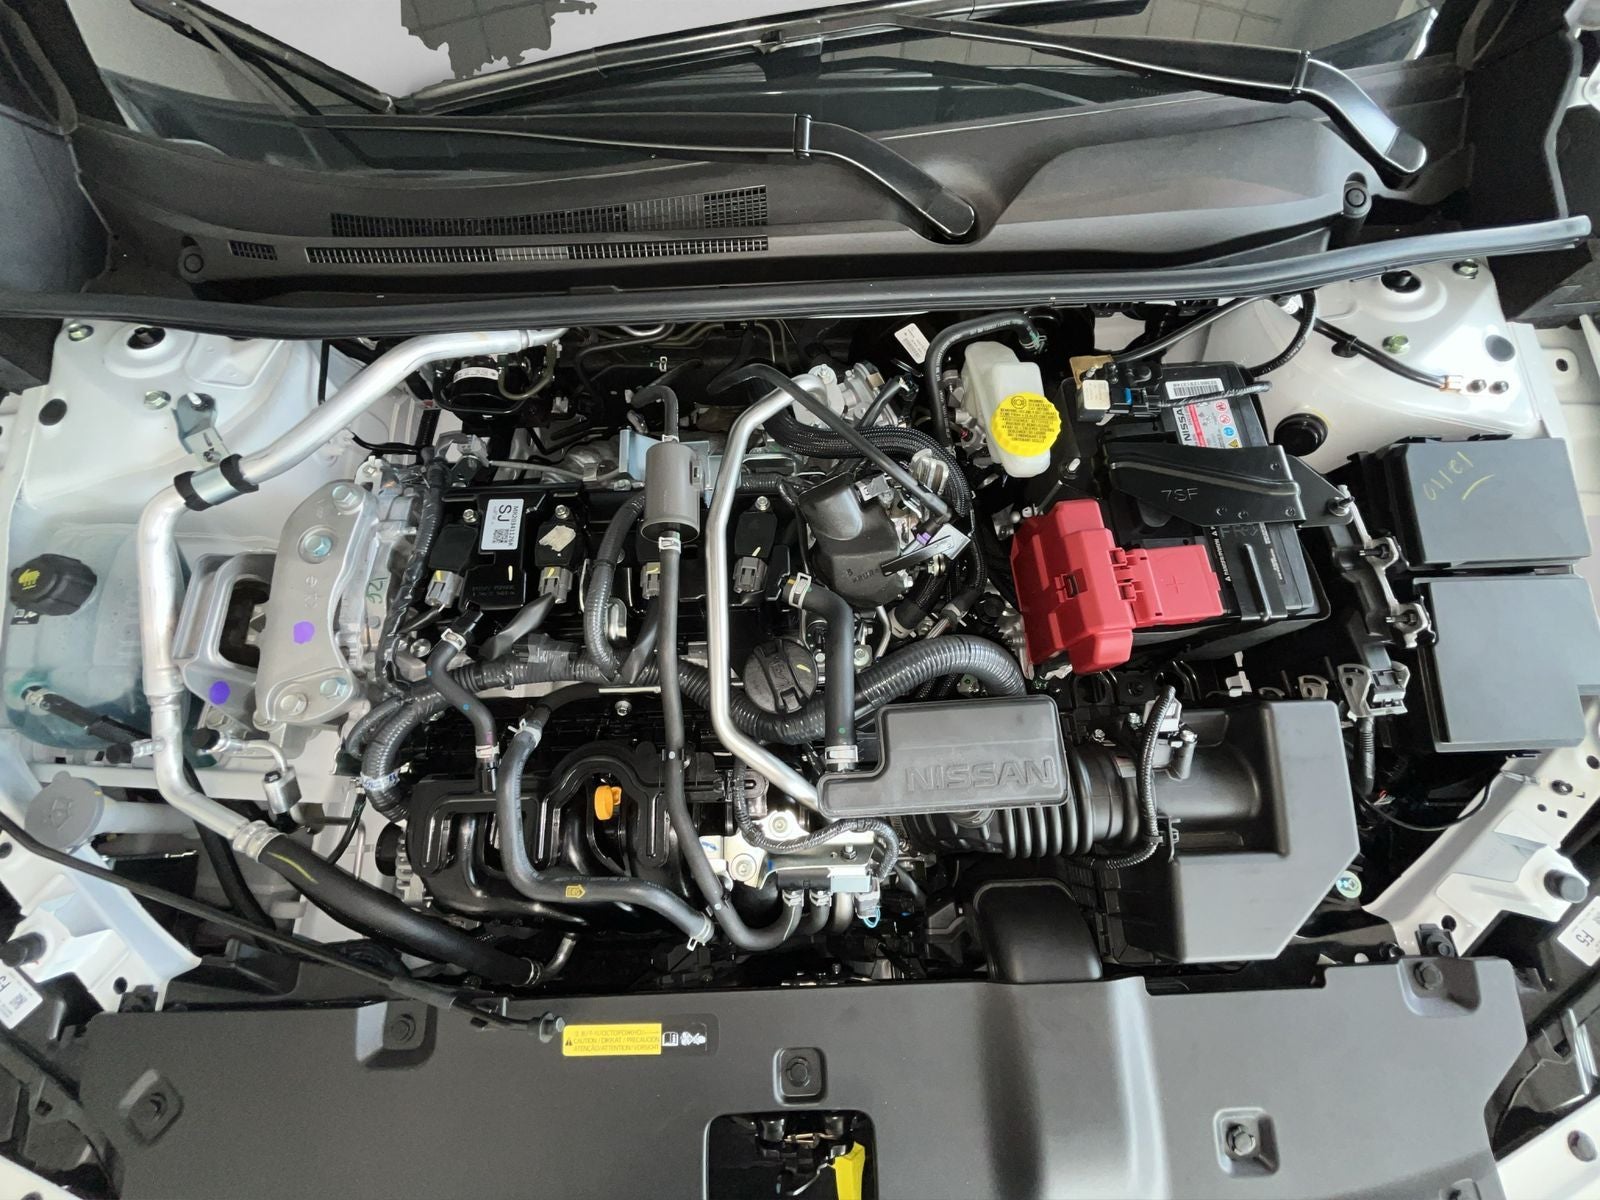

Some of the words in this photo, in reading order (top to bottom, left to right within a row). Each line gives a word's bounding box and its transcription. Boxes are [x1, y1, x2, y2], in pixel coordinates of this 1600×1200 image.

[1177, 409, 1192, 441] NISSA
[1161, 487, 1198, 501] 7SF
[497, 504, 512, 522] SJ
[904, 757, 1057, 792] NISSAN
